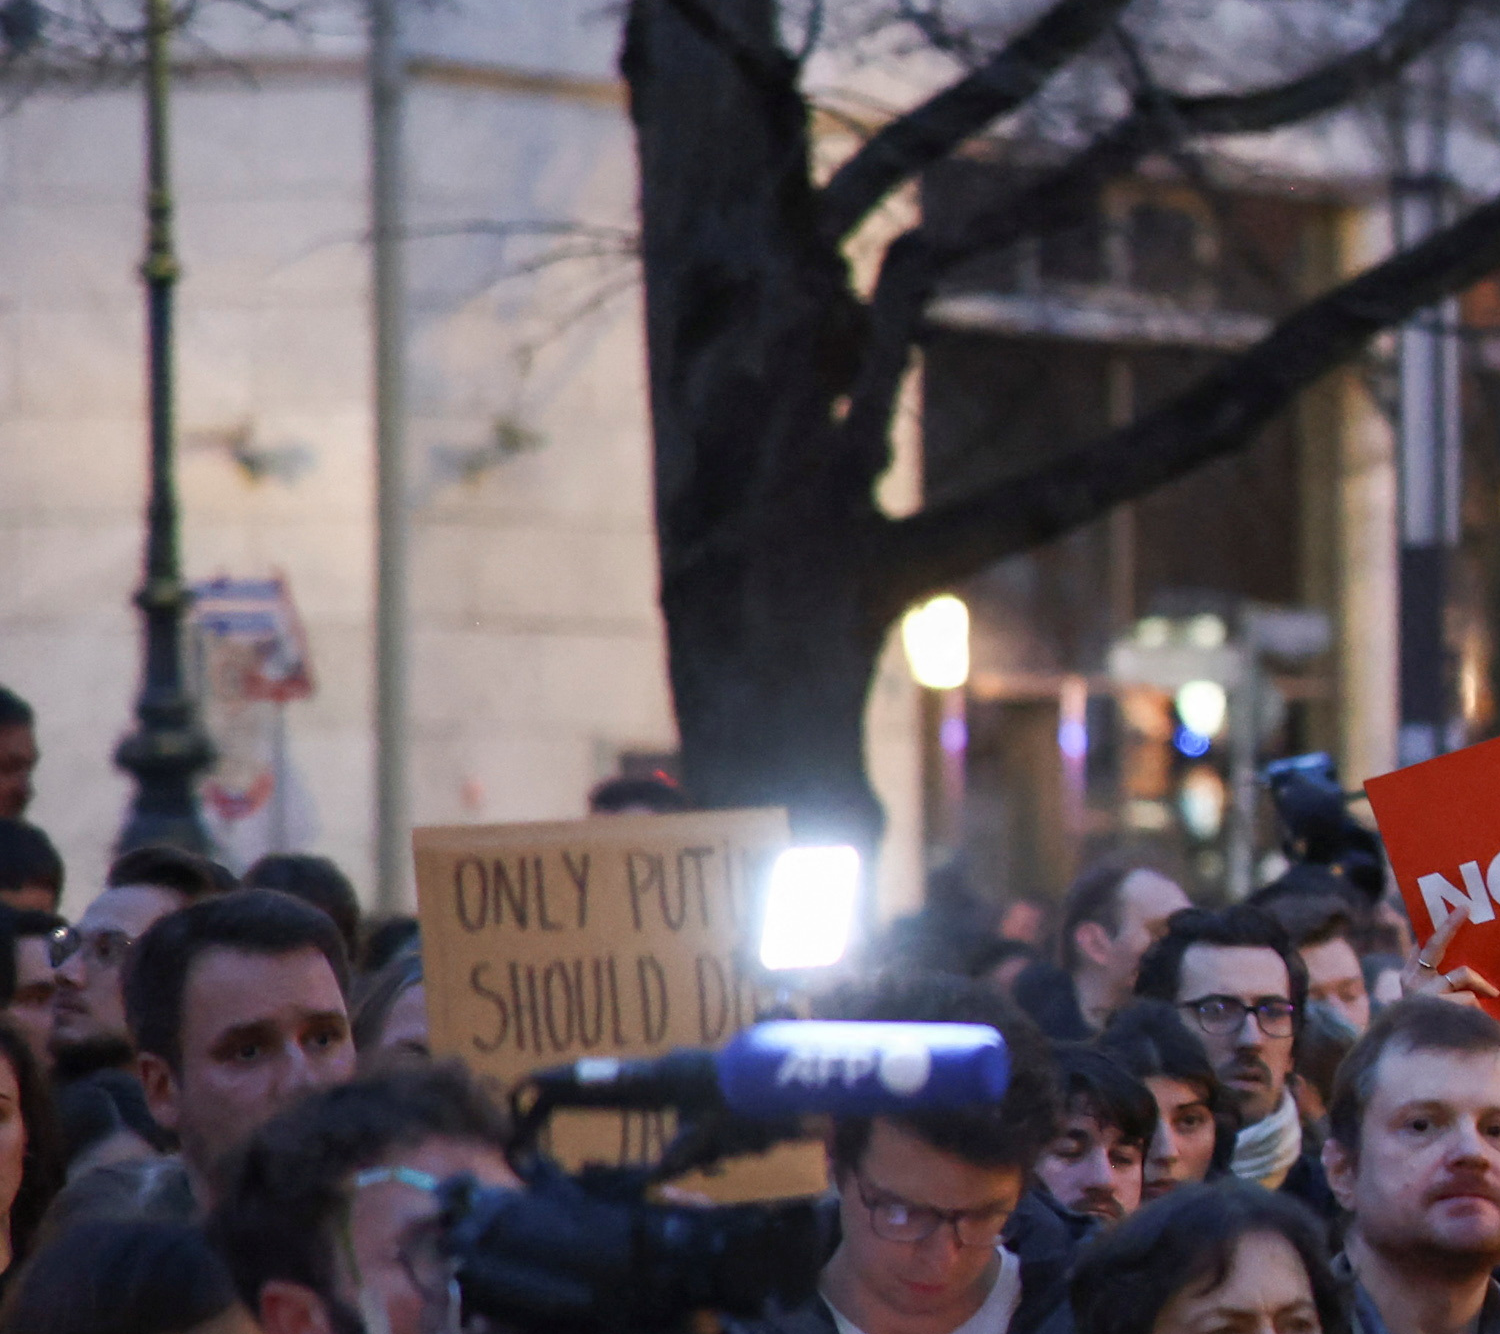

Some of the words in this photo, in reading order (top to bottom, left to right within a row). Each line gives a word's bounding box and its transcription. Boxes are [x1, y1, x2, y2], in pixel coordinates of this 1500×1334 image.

[453, 848, 592, 934] ONLY
[469, 952, 669, 1057] SHOULD
[695, 953, 757, 1046] DI
